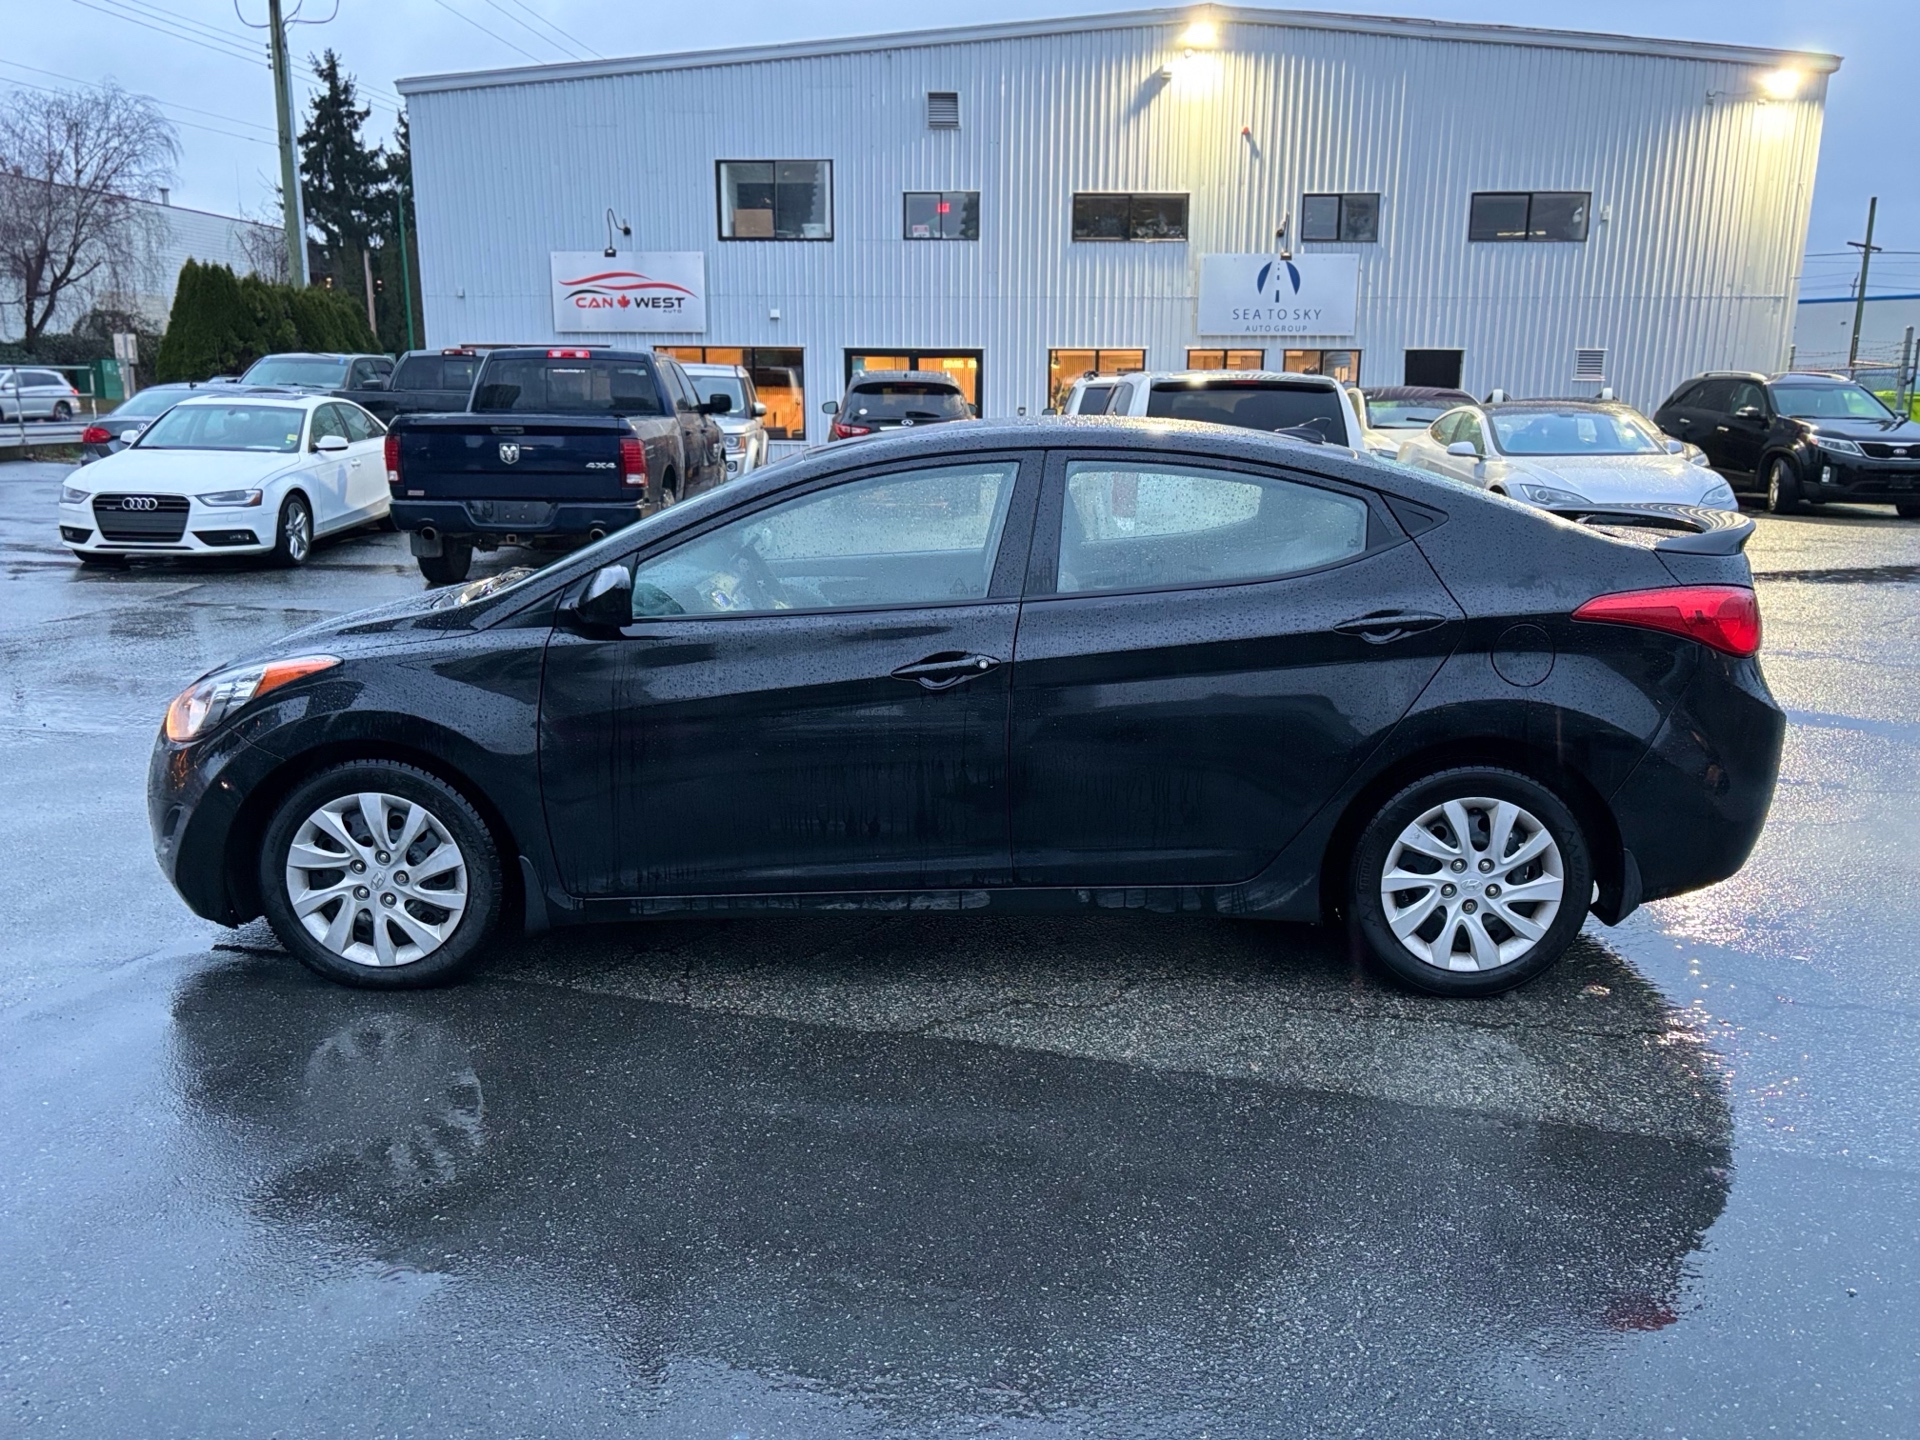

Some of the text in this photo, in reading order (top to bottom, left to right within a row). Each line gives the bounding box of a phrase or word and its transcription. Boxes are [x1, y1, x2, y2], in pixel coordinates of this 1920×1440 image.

[575, 297, 685, 308] CAN WEST
[1232, 308, 1322, 321] SEA TO SKY
